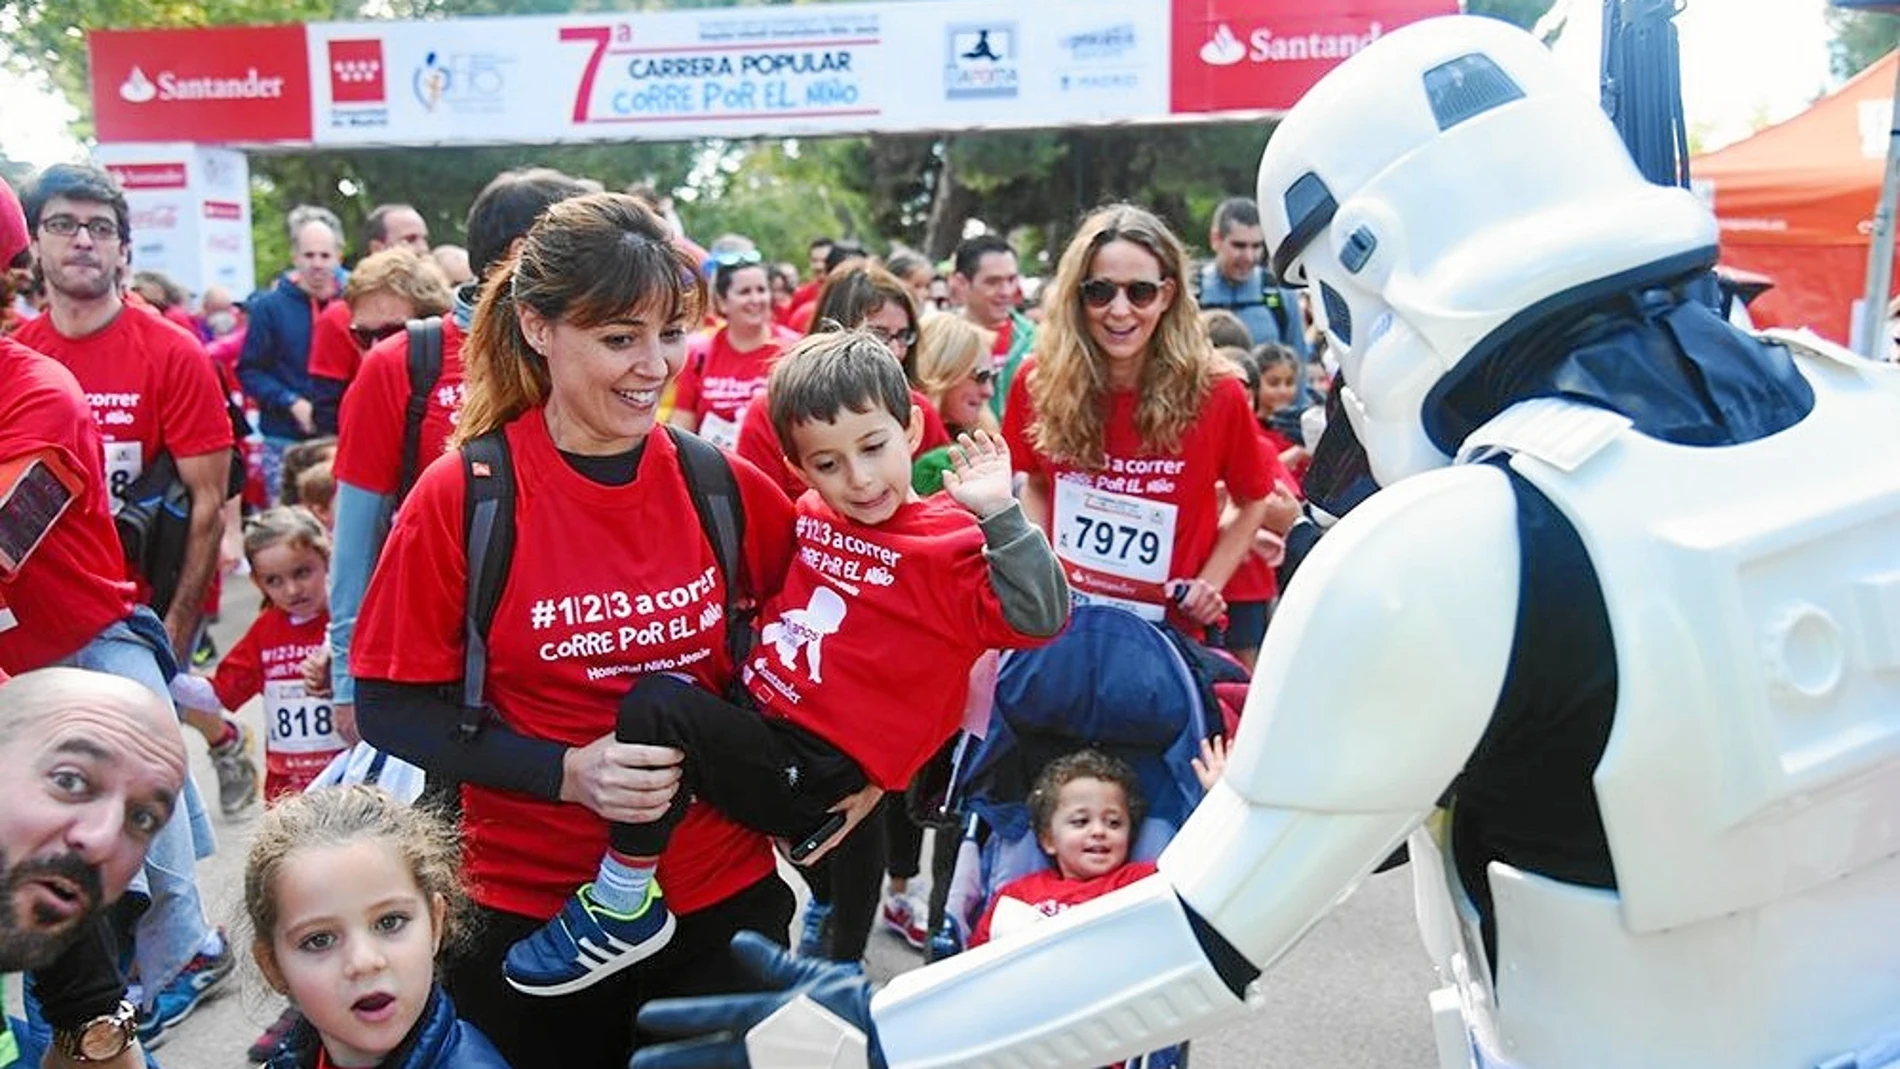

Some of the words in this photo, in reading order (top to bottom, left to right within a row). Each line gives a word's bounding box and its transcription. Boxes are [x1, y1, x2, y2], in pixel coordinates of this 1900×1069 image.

[1250, 21, 1383, 62] Santand
[629, 56, 732, 79] CARRERA
[742, 51, 851, 75] POPULAR
[157, 68, 284, 101] Santander
[764, 80, 795, 108] EL
[1126, 459, 1185, 475] correr
[844, 536, 901, 568] correr
[1075, 515, 1159, 565] 7979
[668, 615, 697, 641] EL
[586, 662, 642, 681] Hospital
[644, 658, 675, 674] Niño
[277, 704, 332, 738] 818
